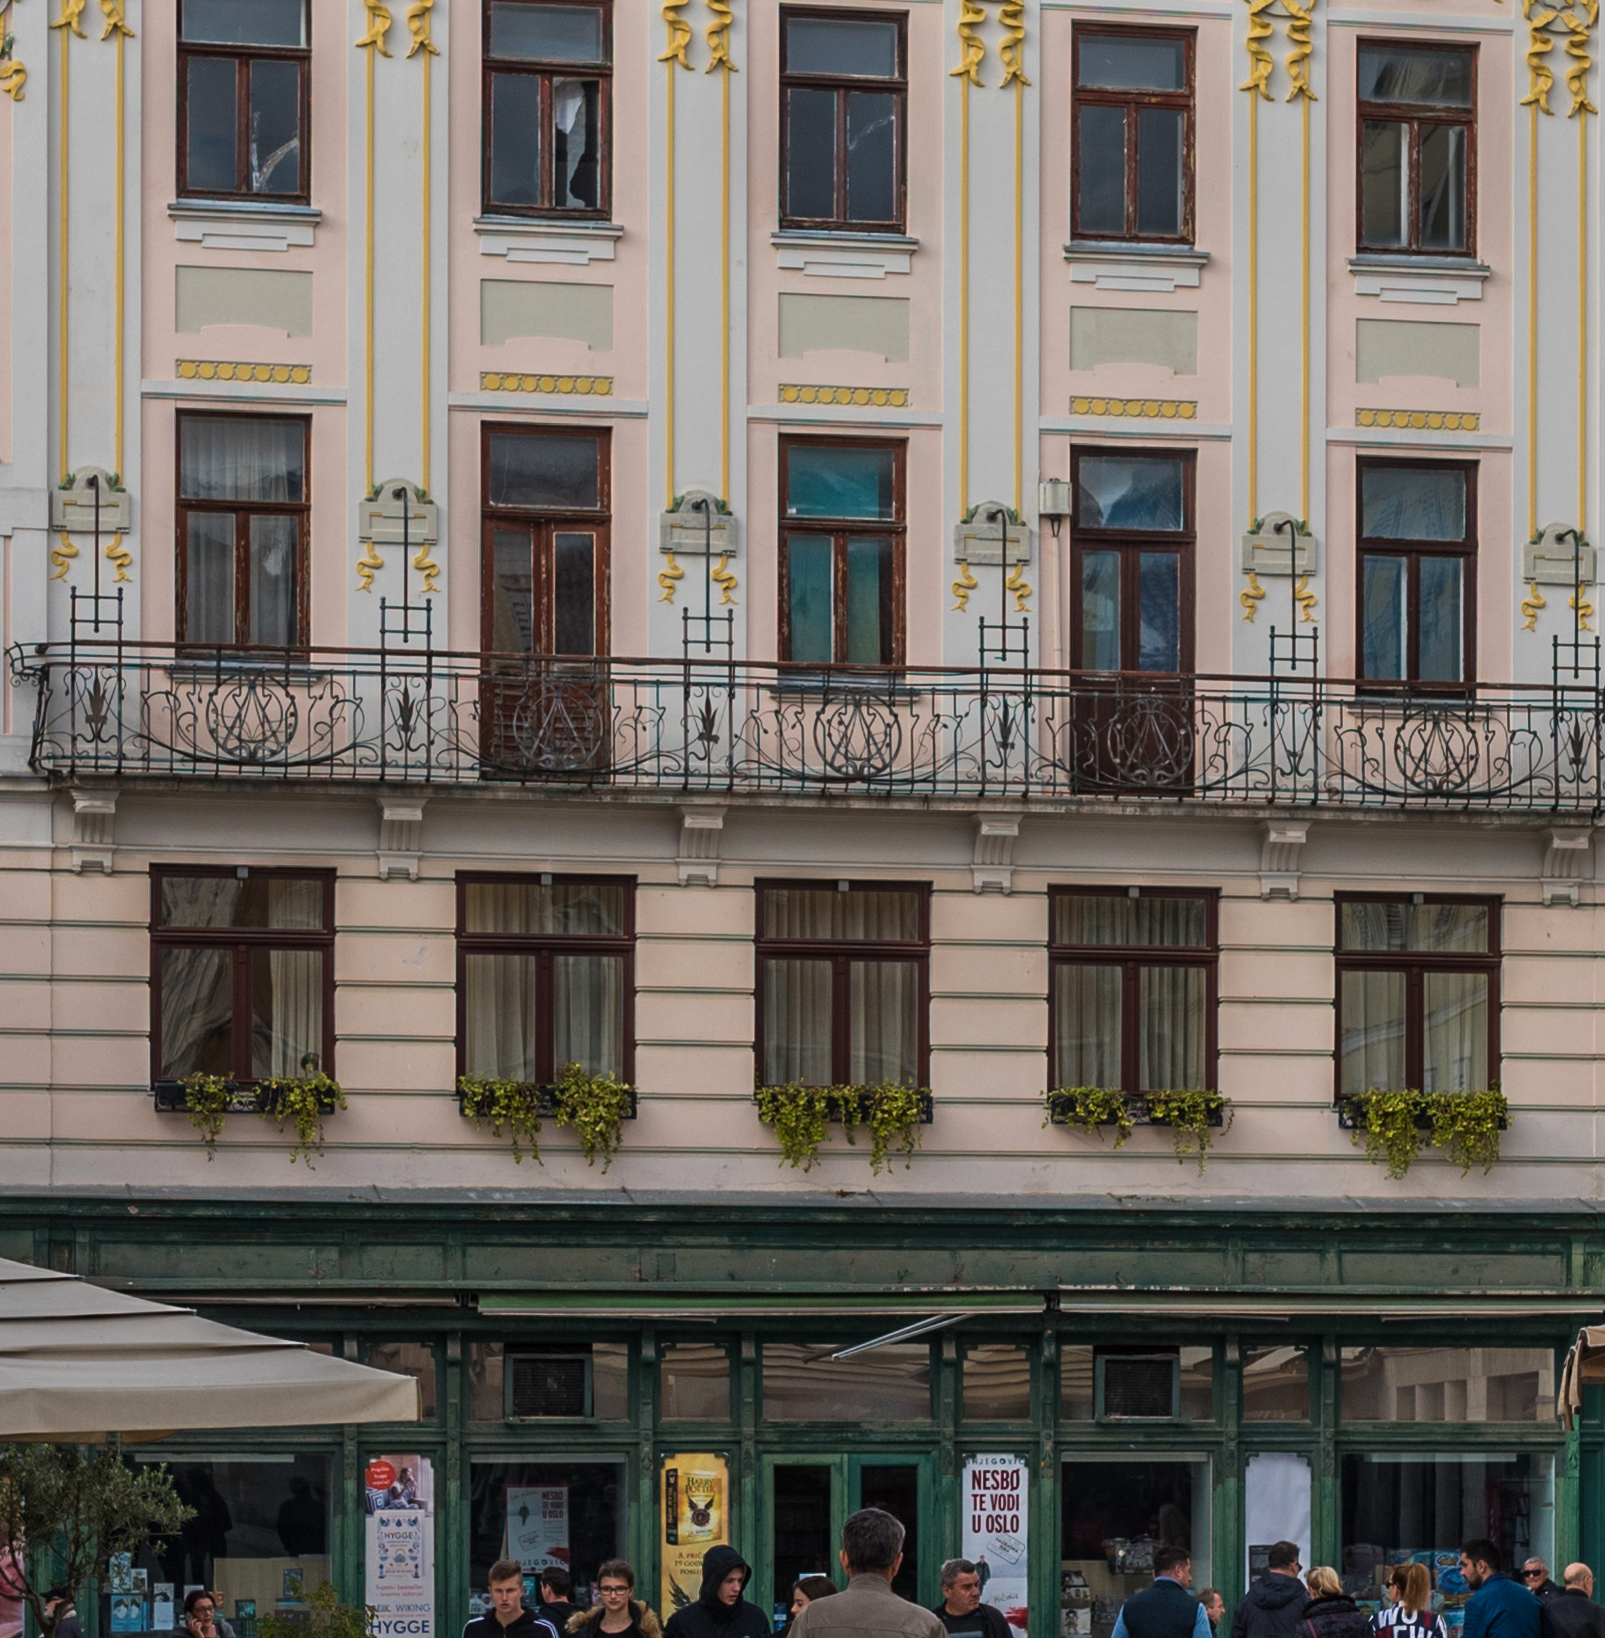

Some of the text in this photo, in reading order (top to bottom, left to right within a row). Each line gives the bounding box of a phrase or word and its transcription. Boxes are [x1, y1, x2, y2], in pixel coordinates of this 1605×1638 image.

[971, 1468, 1020, 1491] NESBØ
[971, 1494, 1019, 1511] TE VODI
[972, 1514, 1020, 1533] U OSLO
[396, 1604, 430, 1612] WIKING
[370, 1620, 430, 1634] HYGGE
